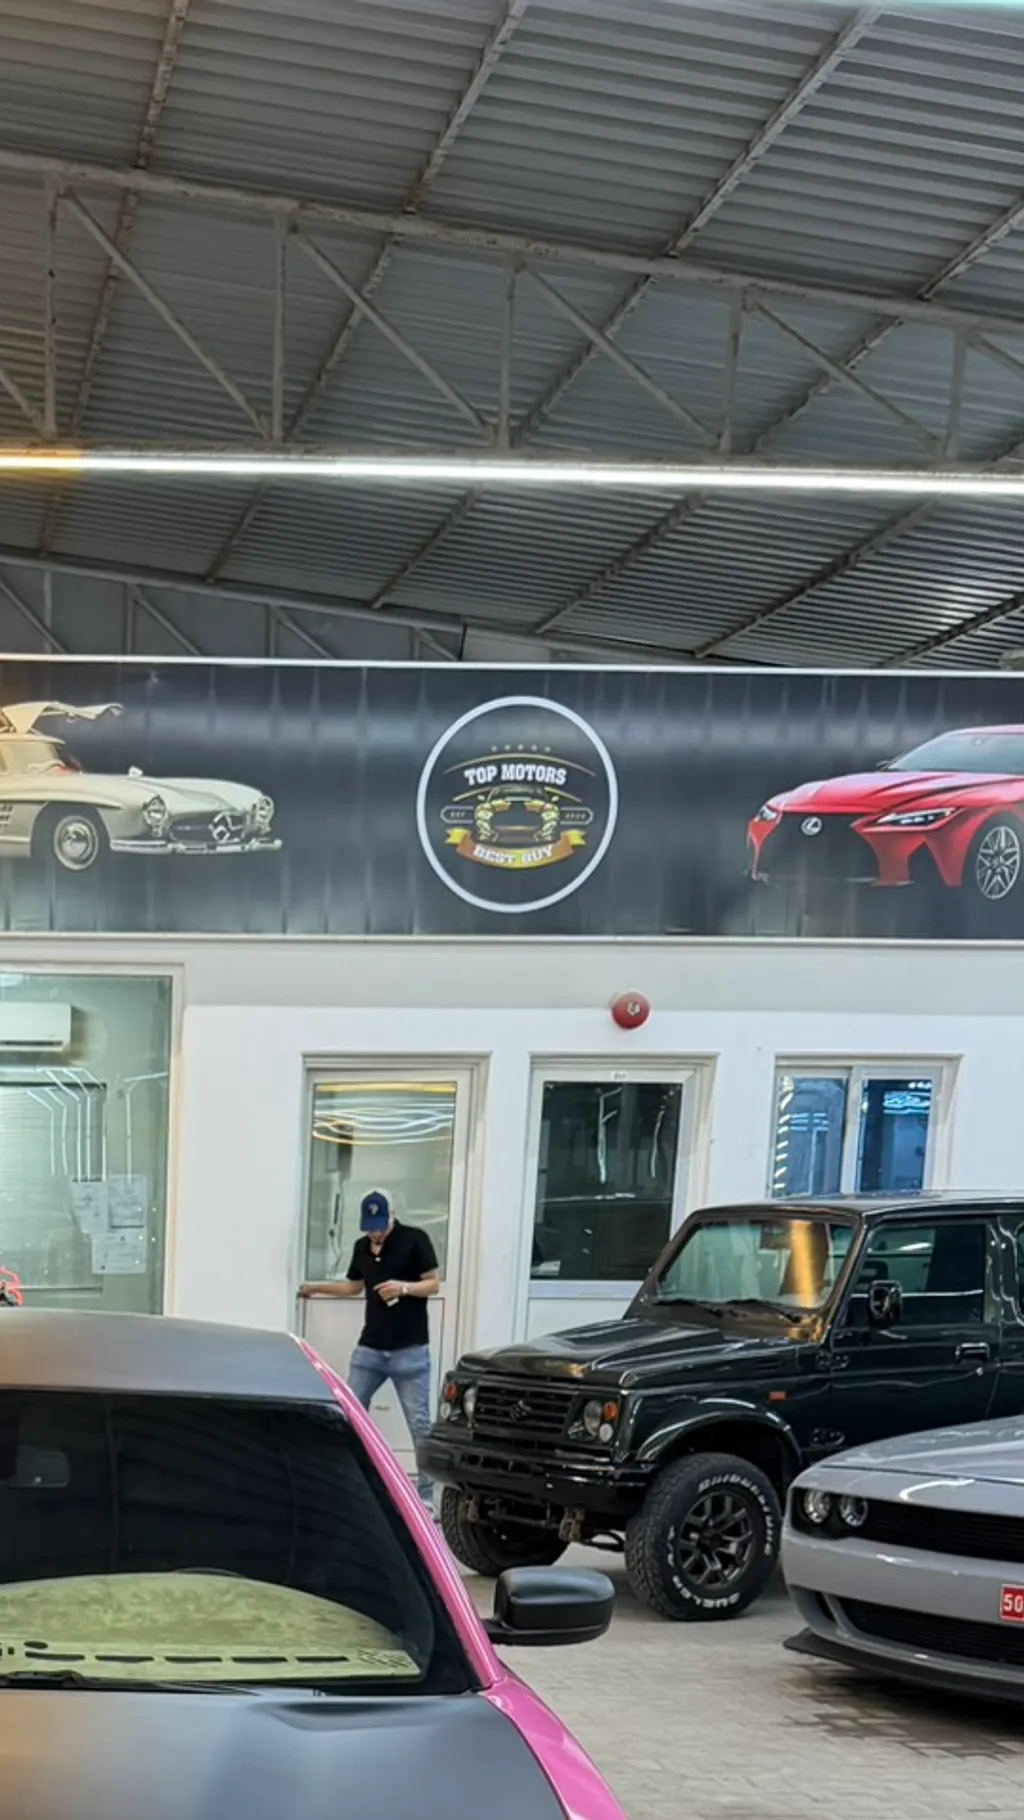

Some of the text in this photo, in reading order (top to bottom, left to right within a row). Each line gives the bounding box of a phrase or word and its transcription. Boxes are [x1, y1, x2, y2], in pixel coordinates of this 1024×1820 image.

[464, 764, 567, 786] TOP MOTORS
[473, 843, 553, 865] BEST BUY
